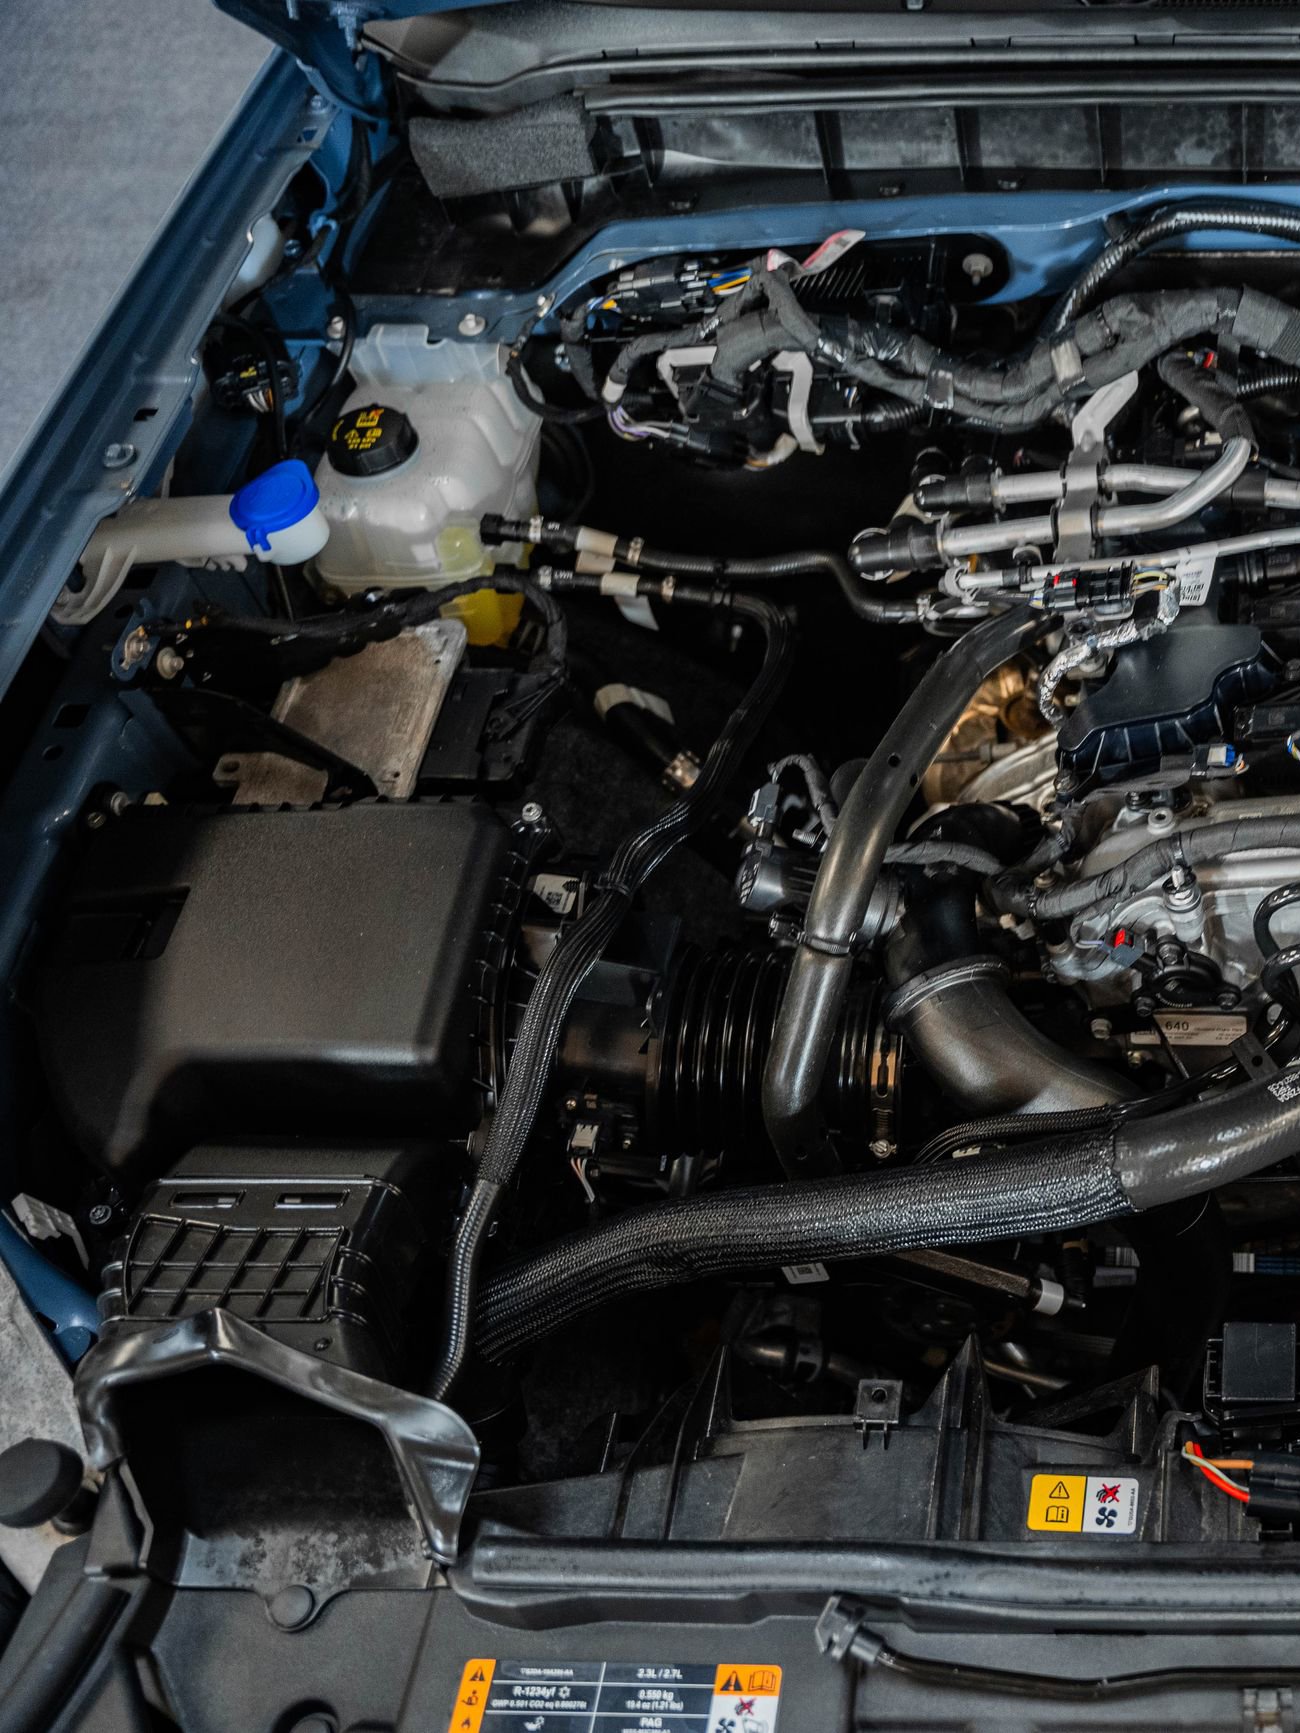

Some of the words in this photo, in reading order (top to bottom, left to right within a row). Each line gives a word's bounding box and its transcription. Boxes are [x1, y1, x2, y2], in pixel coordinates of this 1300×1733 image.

[1165, 1021, 1190, 1031] 640
[637, 1668, 657, 1679] 2.3L
[663, 1669, 683, 1679] 2.7L
[513, 1686, 556, 1699] R-1234yf
[662, 1690, 674, 1701] kg
[639, 1717, 662, 1728] PAG
